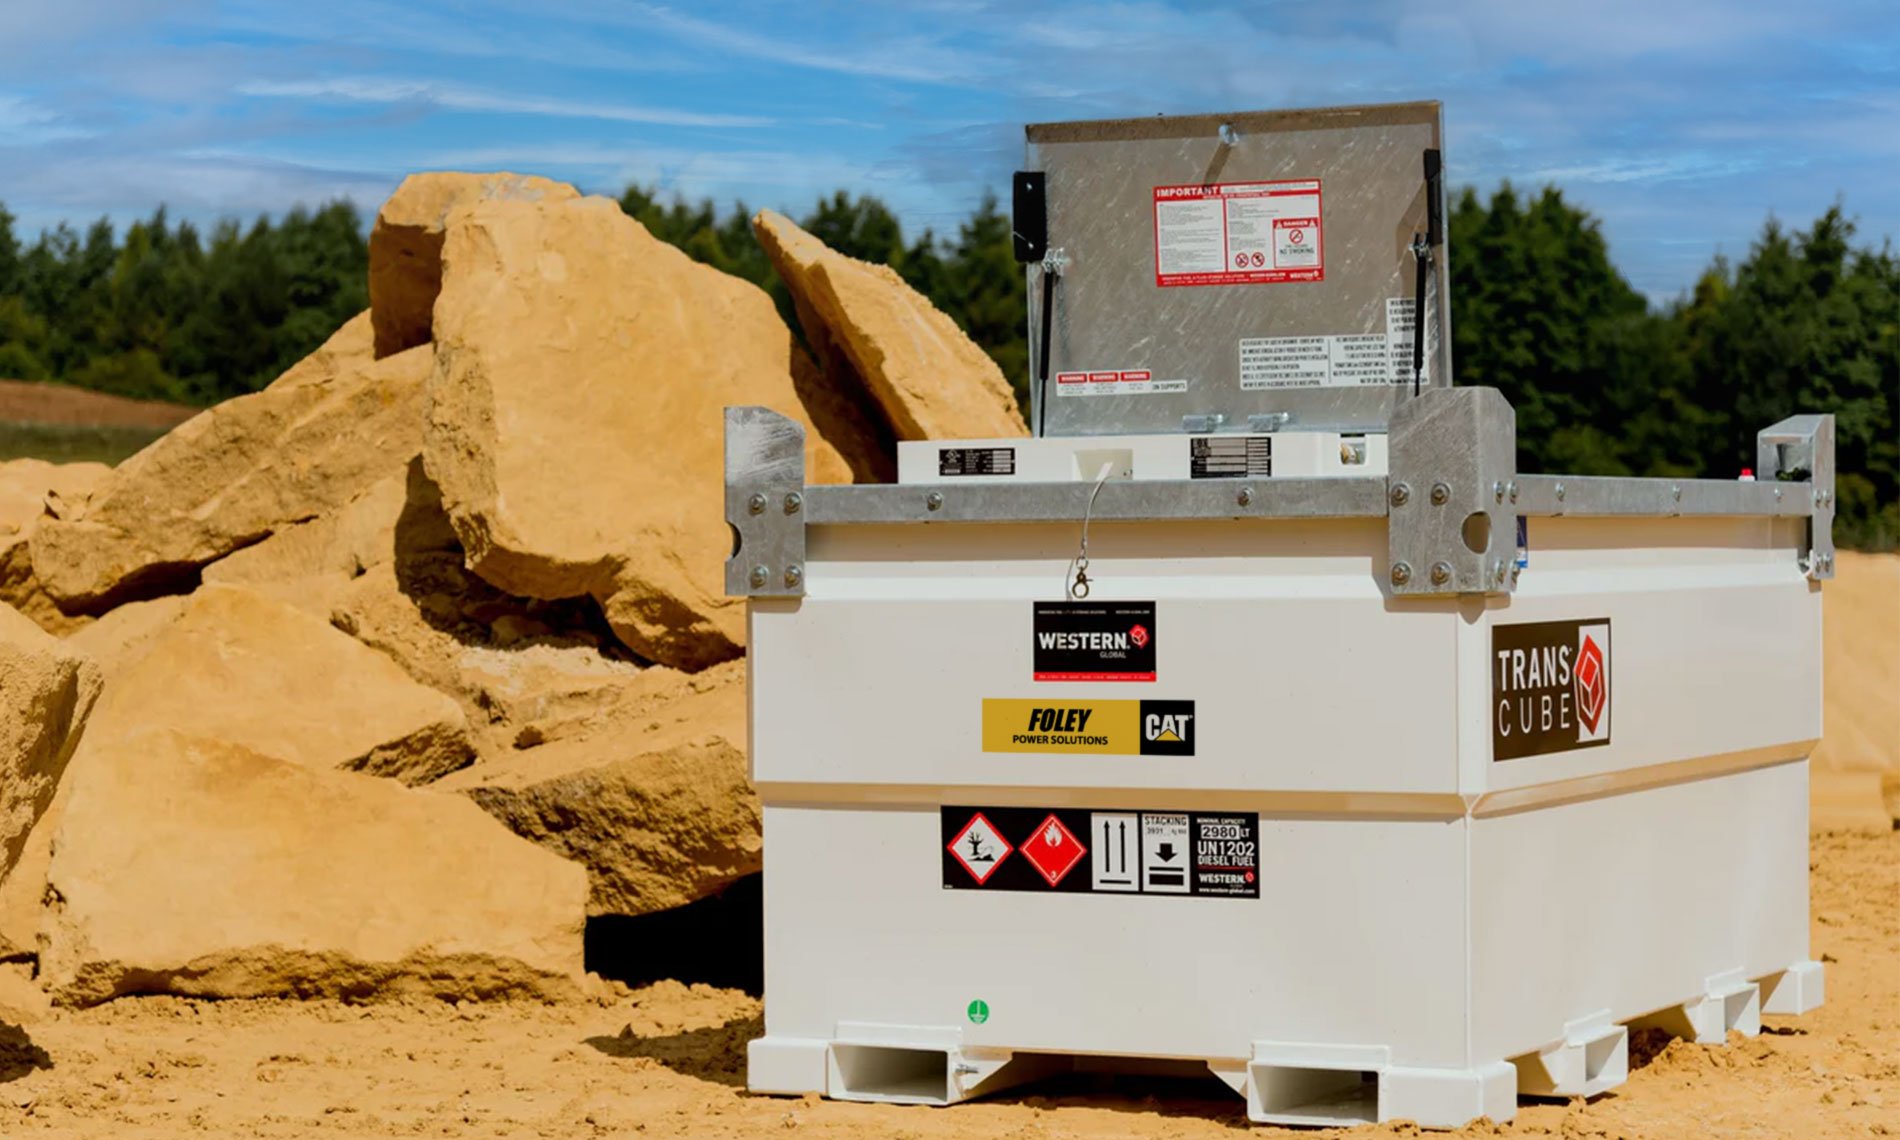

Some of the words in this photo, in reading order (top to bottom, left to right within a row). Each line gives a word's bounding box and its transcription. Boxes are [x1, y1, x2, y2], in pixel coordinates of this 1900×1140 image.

[1157, 186, 1219, 198] IMPORTANT
[1038, 632, 1128, 650] WESTERN
[1099, 651, 1127, 659] GLOBAL
[1498, 645, 1571, 692] TRANS
[1028, 708, 1093, 732] FOLEY
[1498, 693, 1570, 737] CUBE
[1145, 713, 1189, 742] CAT
[1012, 735, 1049, 745] POWER
[1051, 735, 1109, 746] SOLUTIONS
[1144, 815, 1187, 826] STACKING
[1202, 826, 1237, 838] 2980
[1240, 828, 1250, 838] LT
[1197, 841, 1255, 857] UN1202
[1197, 855, 1230, 866] DIESEL
[1231, 856, 1255, 867] FUEL
[1198, 873, 1246, 884] WESTERN
